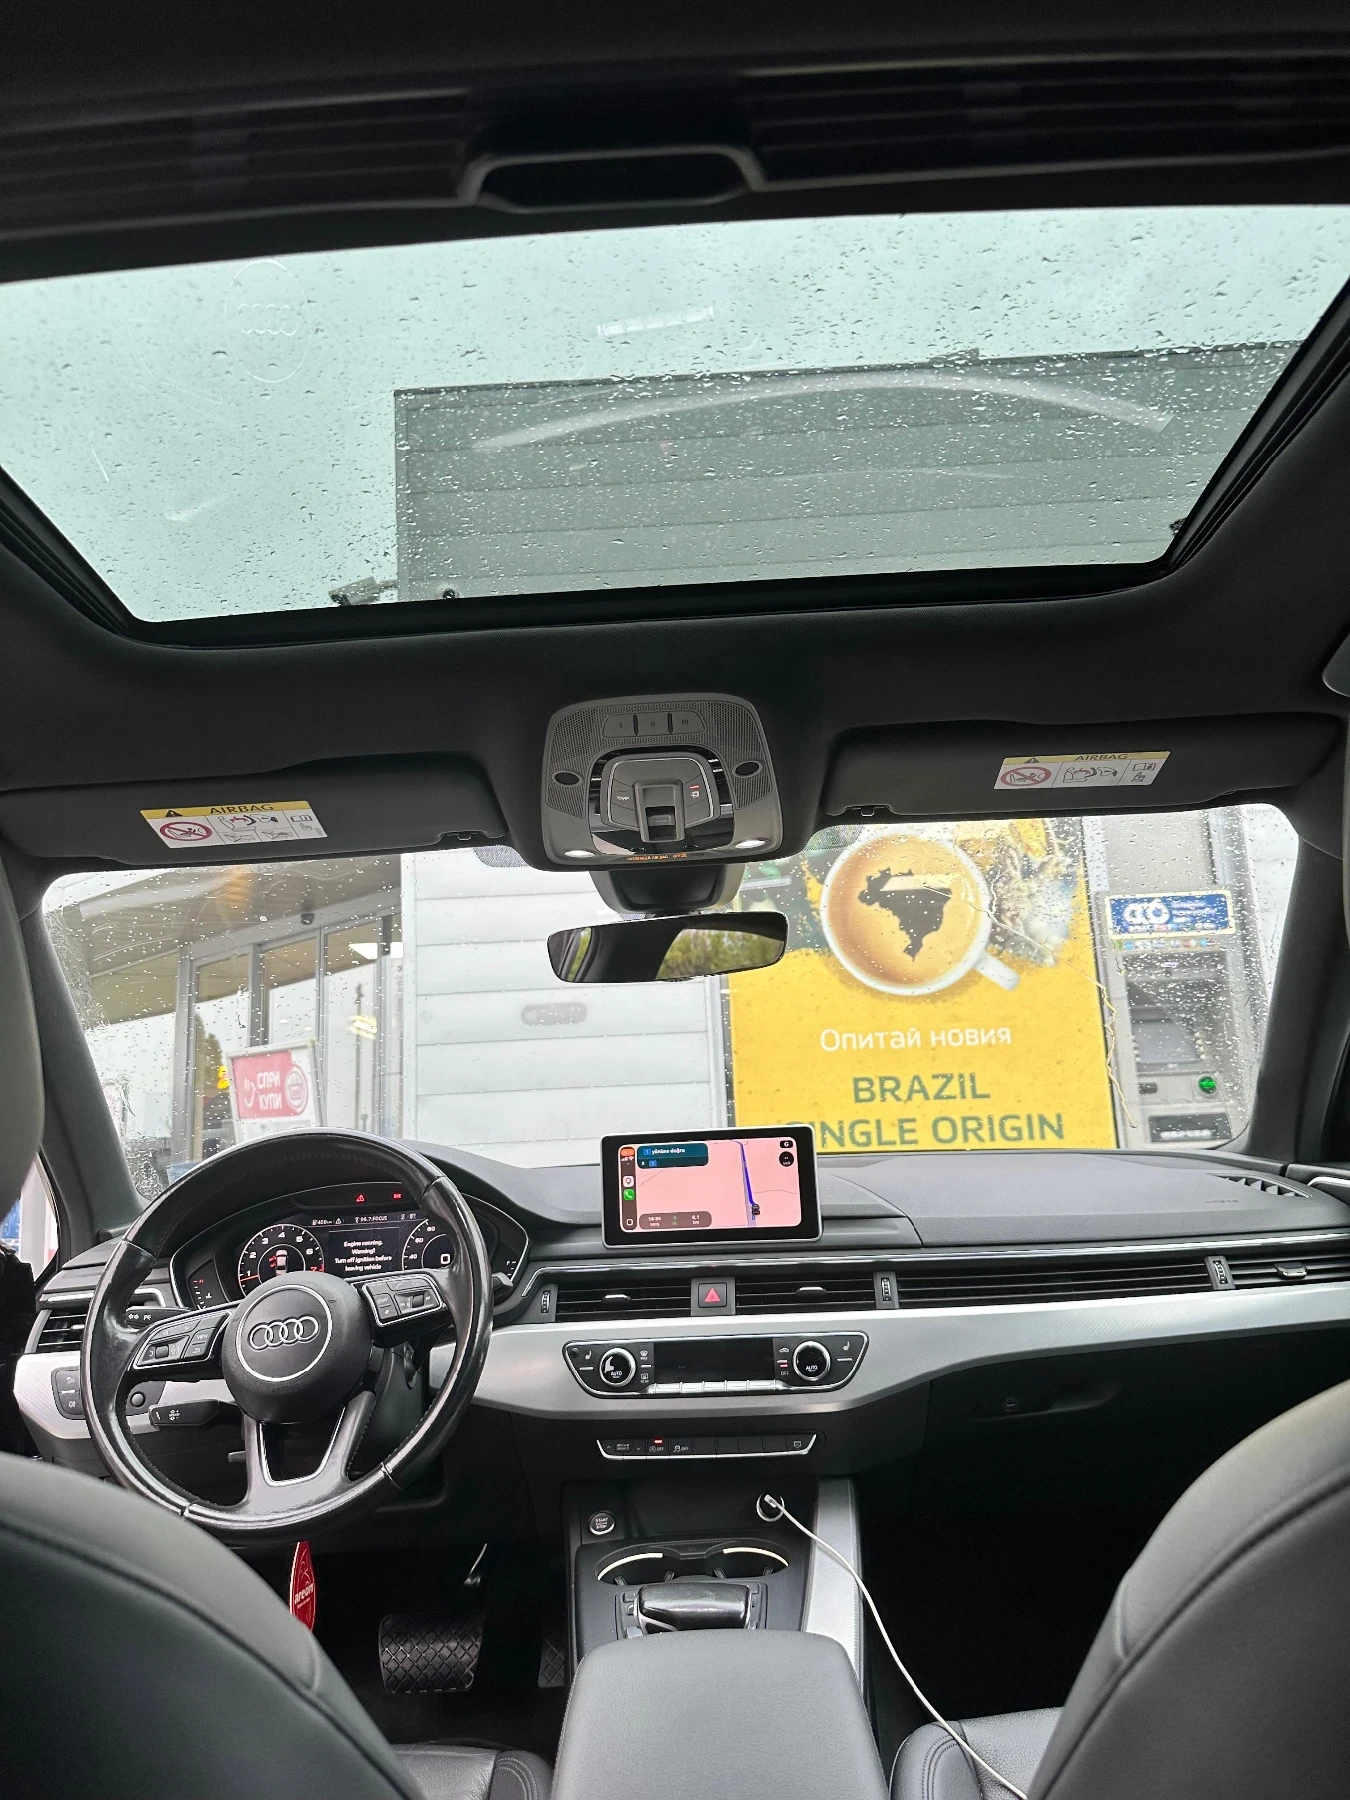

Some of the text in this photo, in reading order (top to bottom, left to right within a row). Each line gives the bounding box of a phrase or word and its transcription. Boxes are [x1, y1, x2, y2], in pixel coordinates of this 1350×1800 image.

[1074, 753, 1128, 761] AIRBAG
[210, 804, 274, 815] AIRBAG
[820, 1027, 1013, 1051] Опитай новия
[257, 1070, 281, 1089] СПРИ
[852, 1072, 991, 1103] BRAZIL
[258, 1092, 283, 1111] КУПИ
[784, 1113, 1065, 1147] NGLE ORIGIN
[355, 1256, 375, 1264] ignition
[294, 1583, 314, 1605] areon
